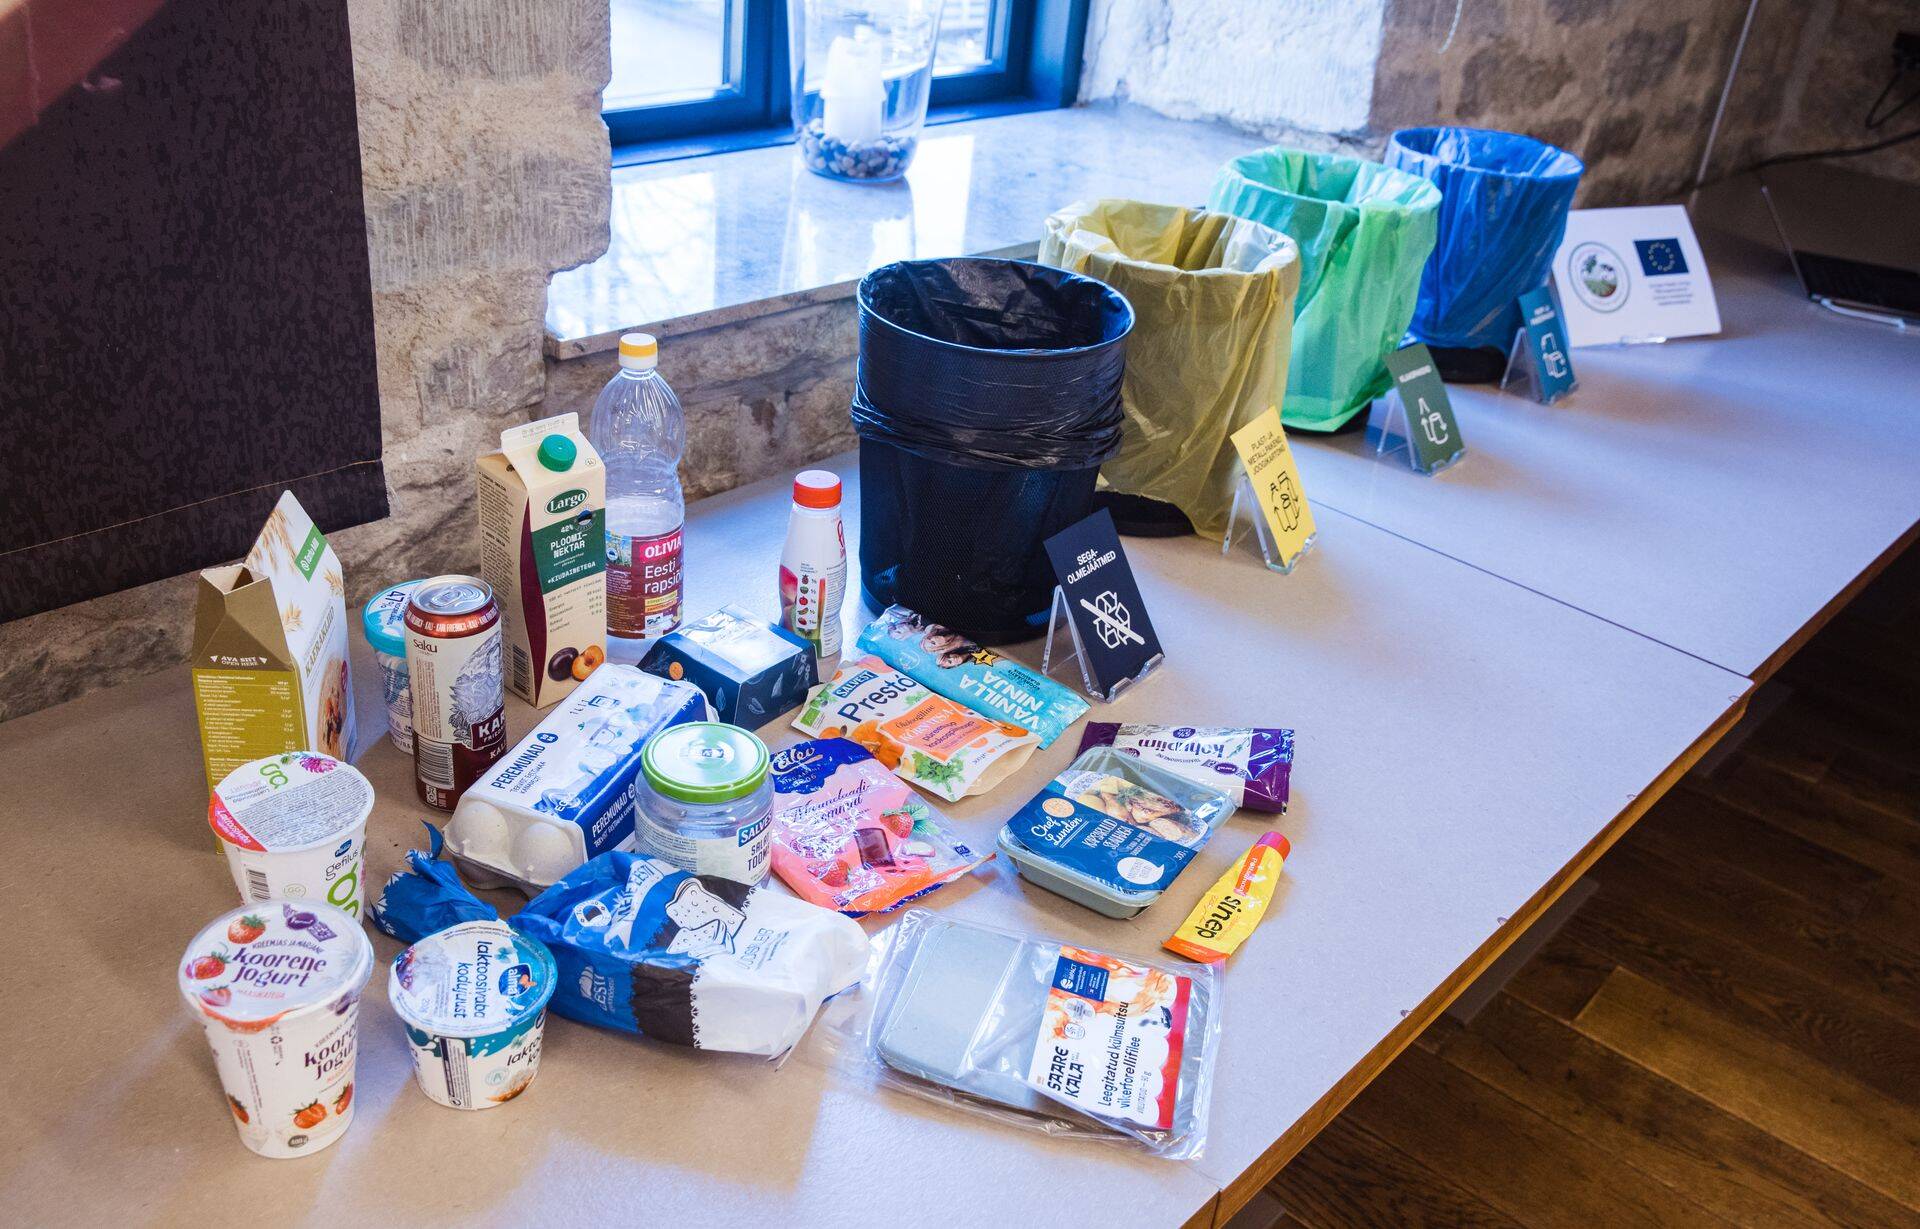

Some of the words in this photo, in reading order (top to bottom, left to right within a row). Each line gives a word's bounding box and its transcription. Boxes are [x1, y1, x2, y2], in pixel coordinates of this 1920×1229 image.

[550, 491, 586, 513] Largo
[550, 533, 588, 550] PLOOMI-
[553, 540, 586, 559] NEKTAR
[644, 535, 682, 558] OLIVIA
[1076, 548, 1098, 566] SEGA-
[645, 557, 677, 579] Eesti
[1067, 550, 1117, 585] OLMEJÄÄTMED
[413, 638, 438, 653] saku
[836, 671, 877, 697] SALVEST
[837, 673, 917, 723] Prestó
[983, 670, 1045, 713] NINJA
[958, 673, 1041, 733] VANILLA
[491, 743, 546, 790] PEREMUNAD
[591, 792, 628, 838] PEREMUNAD
[1030, 815, 1060, 840] Chef
[1044, 816, 1083, 846] Lundén
[325, 850, 360, 882] gefilus
[1197, 894, 1242, 940] sinep
[232, 947, 327, 973] koorene
[232, 962, 310, 988] jogurt
[452, 962, 474, 1019] kodujuust
[474, 940, 493, 1019] laktoosivaba
[508, 968, 518, 997] alma
[1047, 1045, 1069, 1092] SAARE
[1097, 1052, 1120, 1108] Leegitatud
[1109, 1001, 1129, 1051] külmsuitsu
[1064, 1062, 1085, 1098] KALA
[1117, 1036, 1141, 1109] vikerforellifilee
